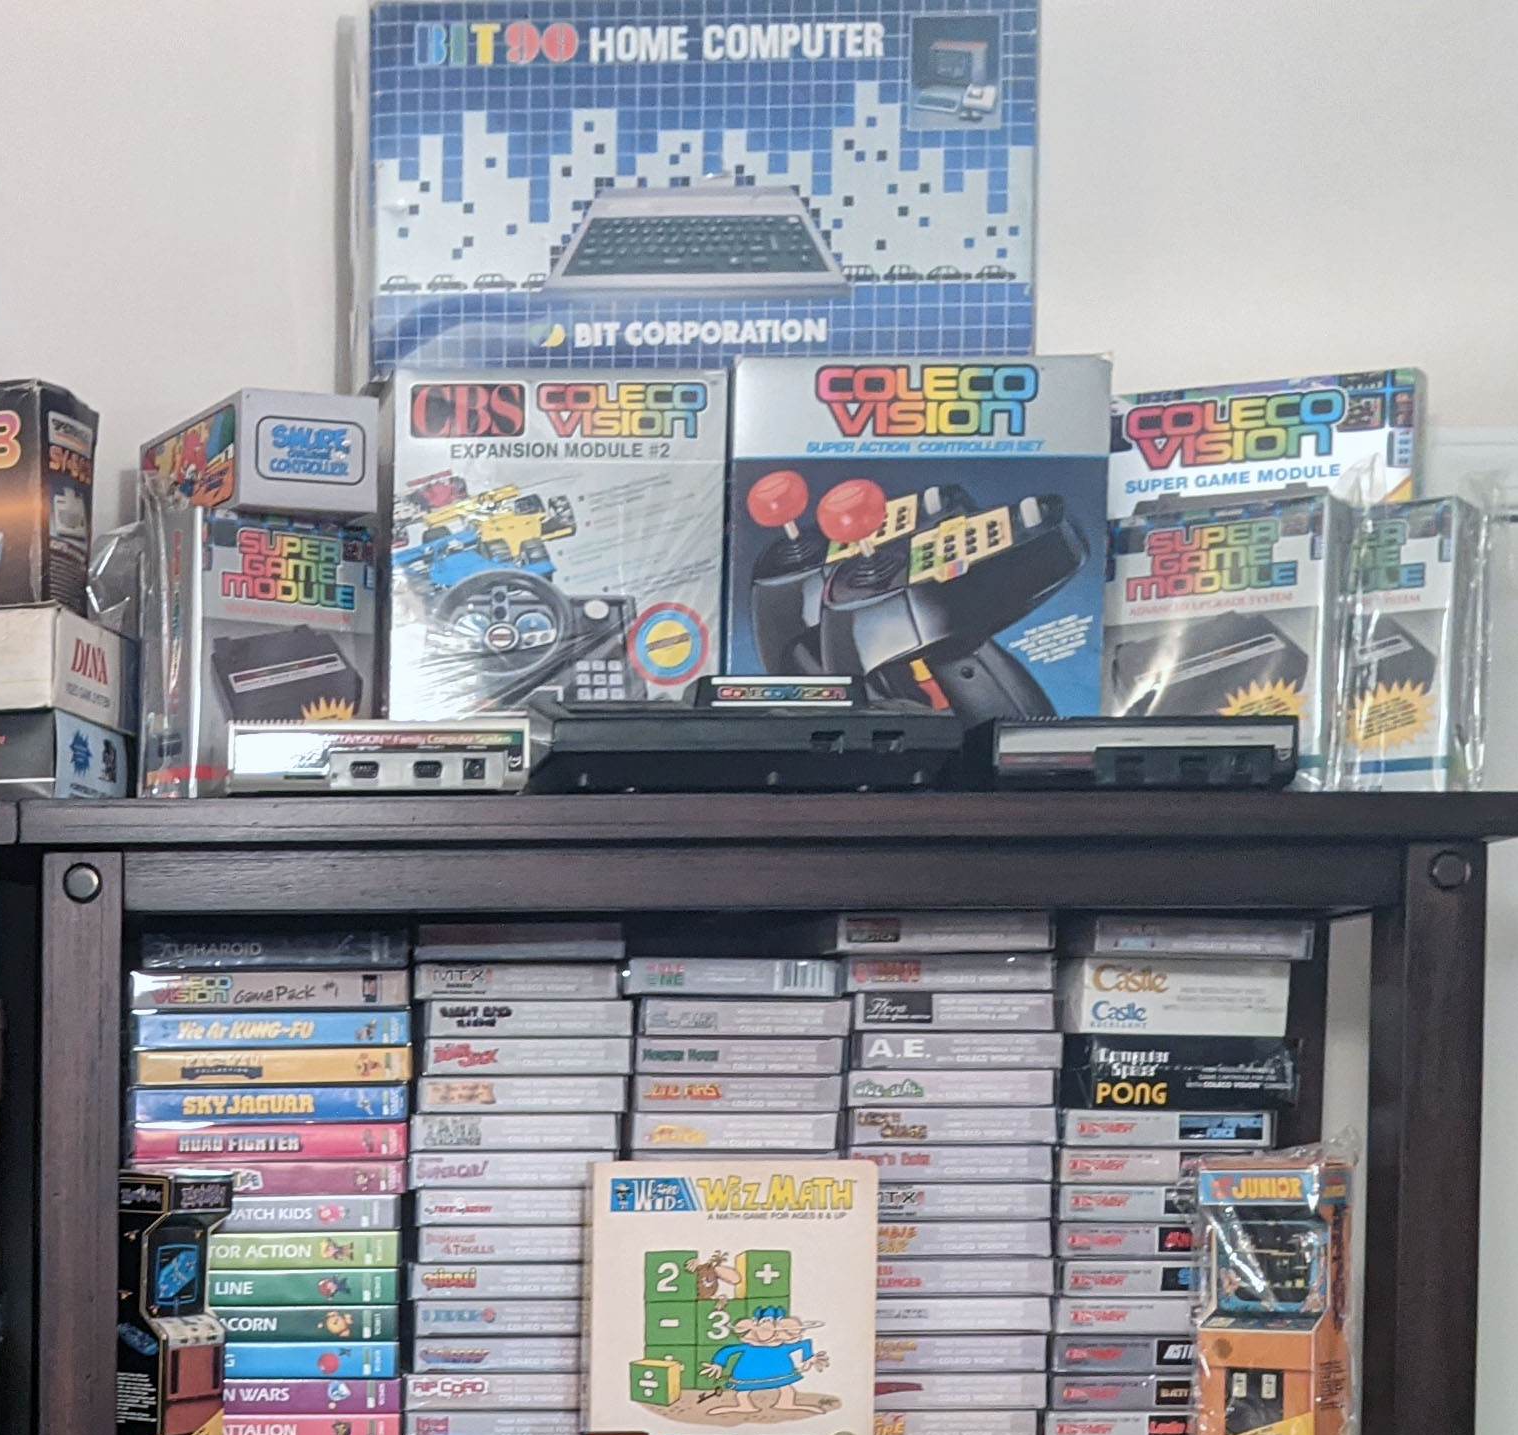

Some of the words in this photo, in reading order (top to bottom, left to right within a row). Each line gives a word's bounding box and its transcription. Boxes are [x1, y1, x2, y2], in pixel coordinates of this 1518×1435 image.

[590, 27, 687, 64] HOME
[702, 22, 884, 61] COMPUTER
[574, 322, 620, 347] BIT
[625, 318, 827, 346] CORPORATION
[537, 383, 707, 413] COLECO
[816, 364, 1038, 402] COLECO
[411, 385, 525, 437] CBS
[548, 408, 698, 438] VISION
[826, 400, 1026, 436] VISION
[1126, 389, 1346, 439] COLECO
[450, 443, 559, 459] EXPANSION
[564, 443, 642, 458] MODULE
[649, 443, 670, 458] #2
[807, 441, 856, 452] SUPER
[858, 441, 911, 453] ACTION
[919, 441, 1014, 453] CONTROLLER
[1017, 441, 1044, 451] SET
[1136, 424, 1336, 469] VISION
[1125, 476, 1188, 495] SUPER
[1195, 472, 1250, 488] GAME
[1257, 464, 1340, 482] MODULE
[238, 530, 341, 561] SUPER
[1147, 519, 1278, 555] SUPER
[1152, 543, 1271, 573] GAME
[221, 571, 354, 609] MODULE
[1126, 561, 1297, 601] MODULE
[70, 637, 108, 685] DINA
[1092, 963, 1170, 994] Castle
[278, 1208, 312, 1220] KIDS
[251, 1244, 312, 1258] ACTION
[215, 1282, 253, 1295] LINE
[656, 1262, 679, 1292] 2
[707, 1312, 731, 1338] 3
[240, 1388, 290, 1401] WARS
